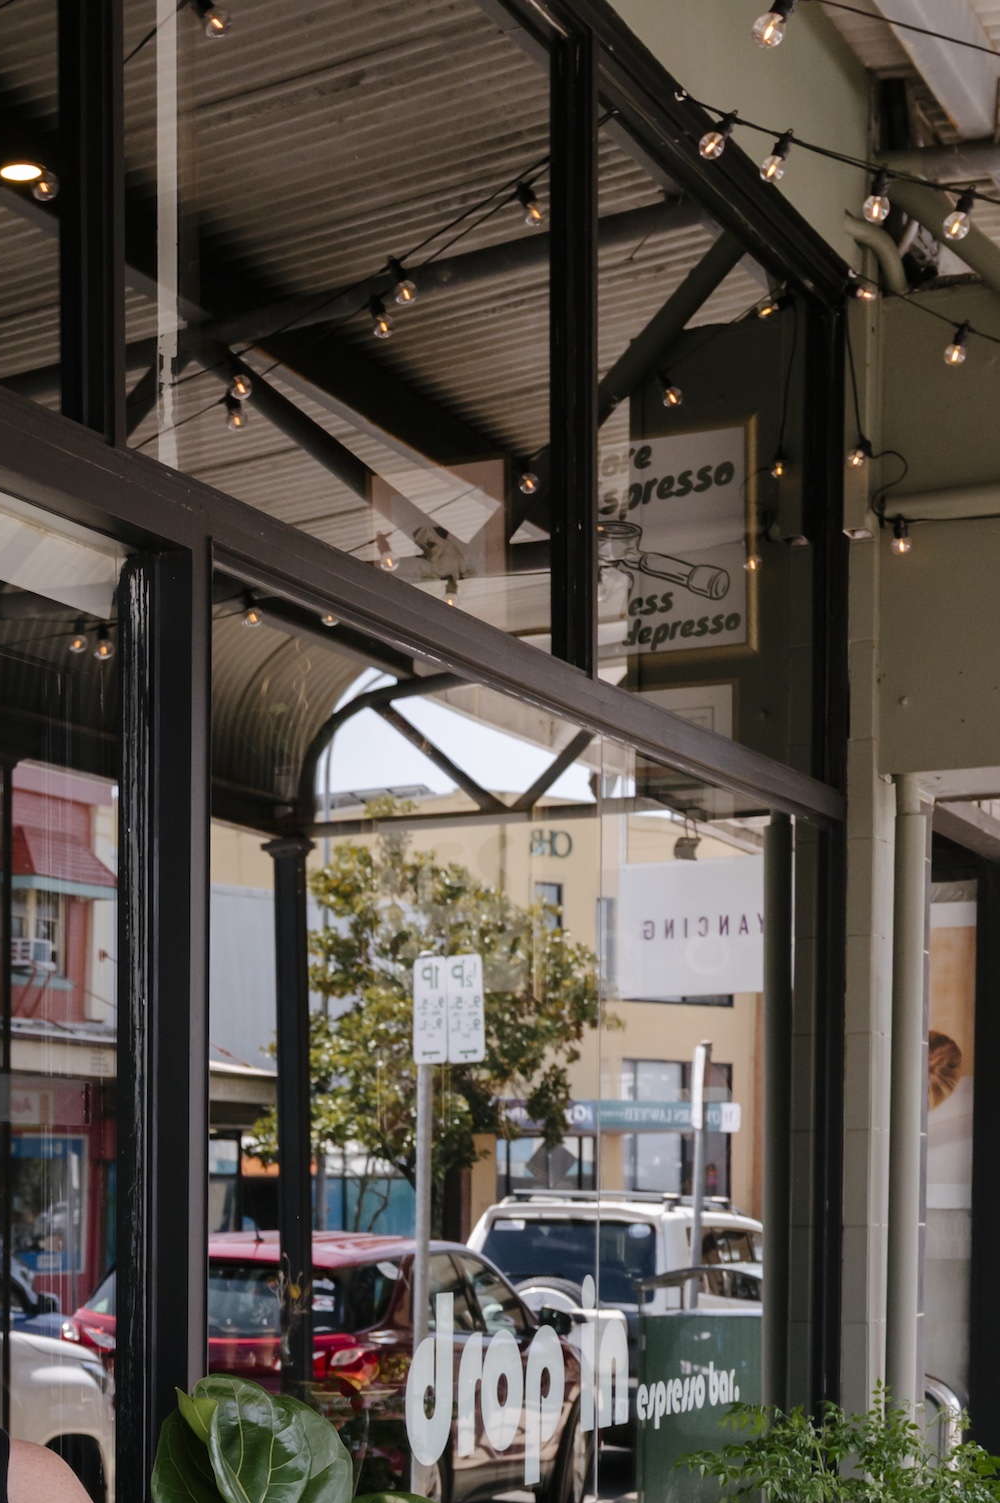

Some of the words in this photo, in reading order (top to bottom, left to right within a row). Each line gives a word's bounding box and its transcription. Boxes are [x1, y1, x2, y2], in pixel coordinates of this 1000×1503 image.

[598, 445, 652, 478] ore
[598, 461, 735, 521] spresso
[627, 591, 673, 617] ess
[405, 1292, 565, 1486] drop
[579, 1273, 630, 1433] in
[636, 1375, 706, 1430] espresso
[708, 1360, 741, 1407] bar.
